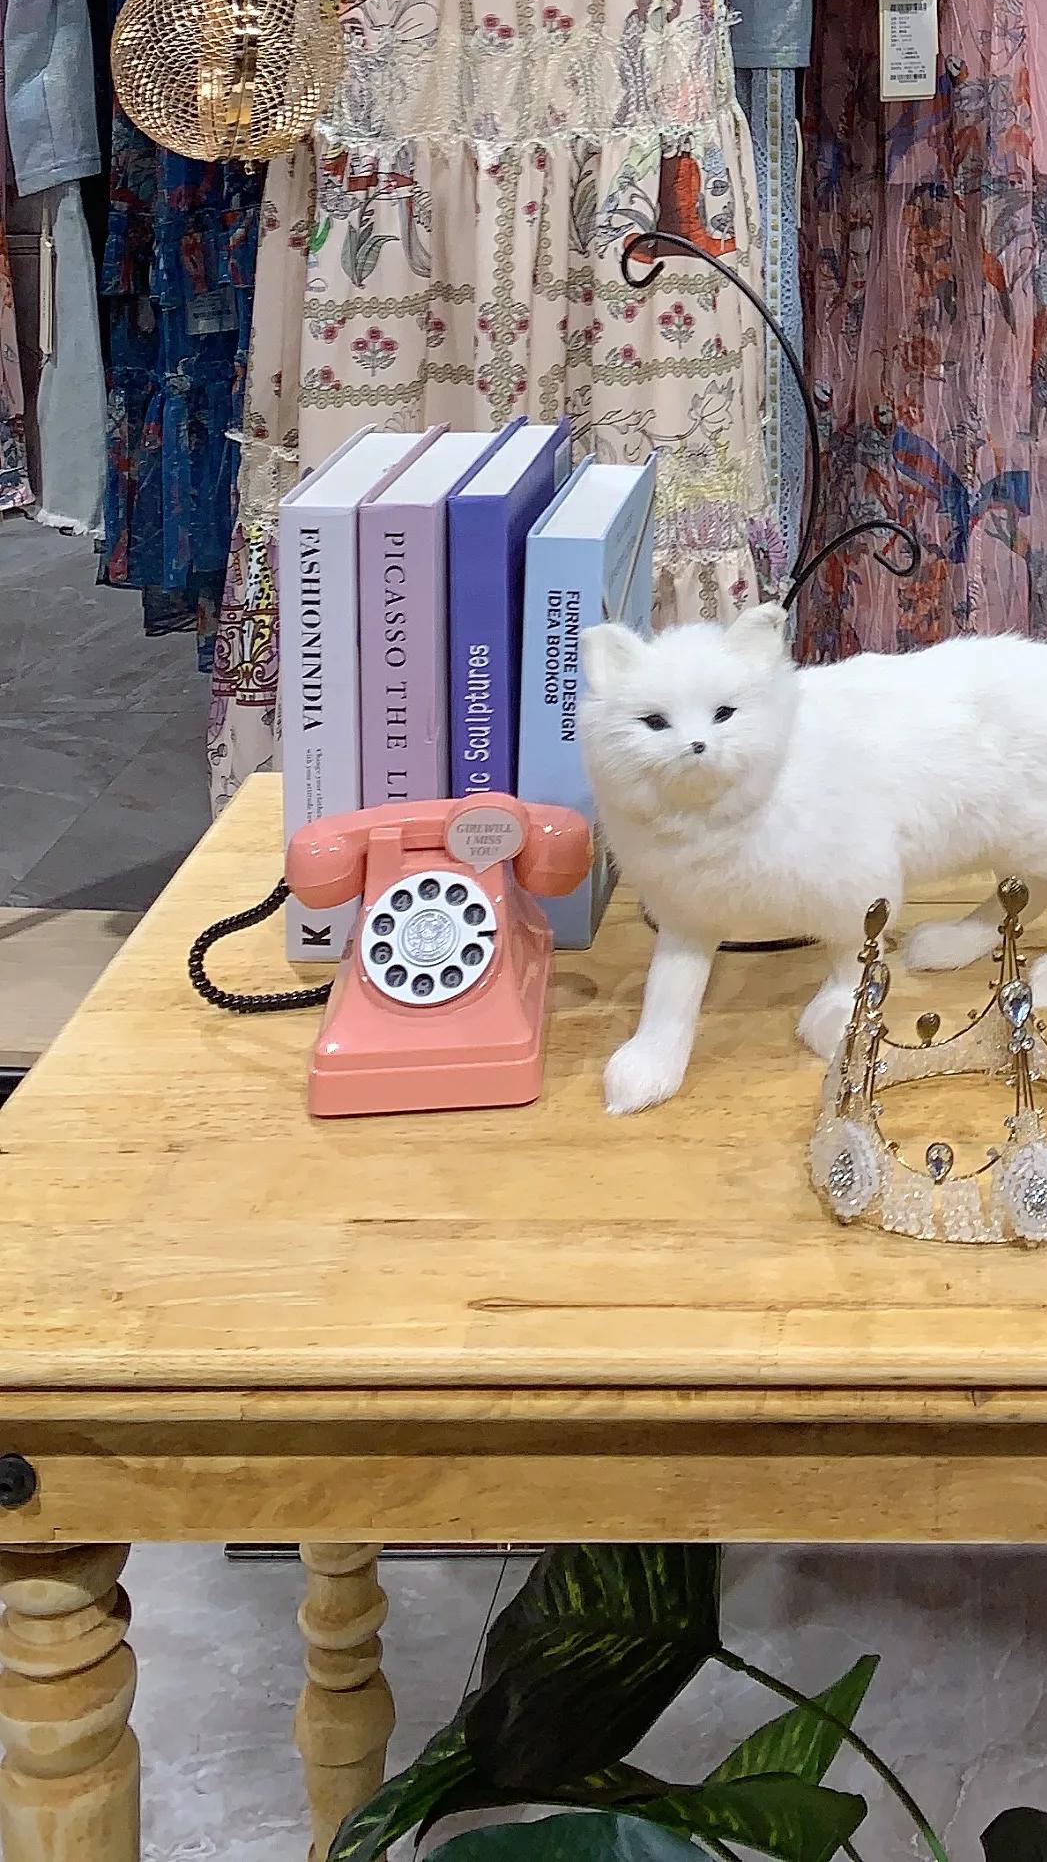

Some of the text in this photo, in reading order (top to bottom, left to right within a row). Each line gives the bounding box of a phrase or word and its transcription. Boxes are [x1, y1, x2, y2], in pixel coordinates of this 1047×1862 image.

[299, 527, 323, 731] FASHIONINDIA
[384, 531, 407, 668] PICASSO
[546, 590, 562, 630] IDEA
[386, 681, 408, 749] THE
[464, 644, 493, 762] Sculptures
[560, 590, 581, 742] FURNITRE DESIGN
[301, 923, 332, 946] K
